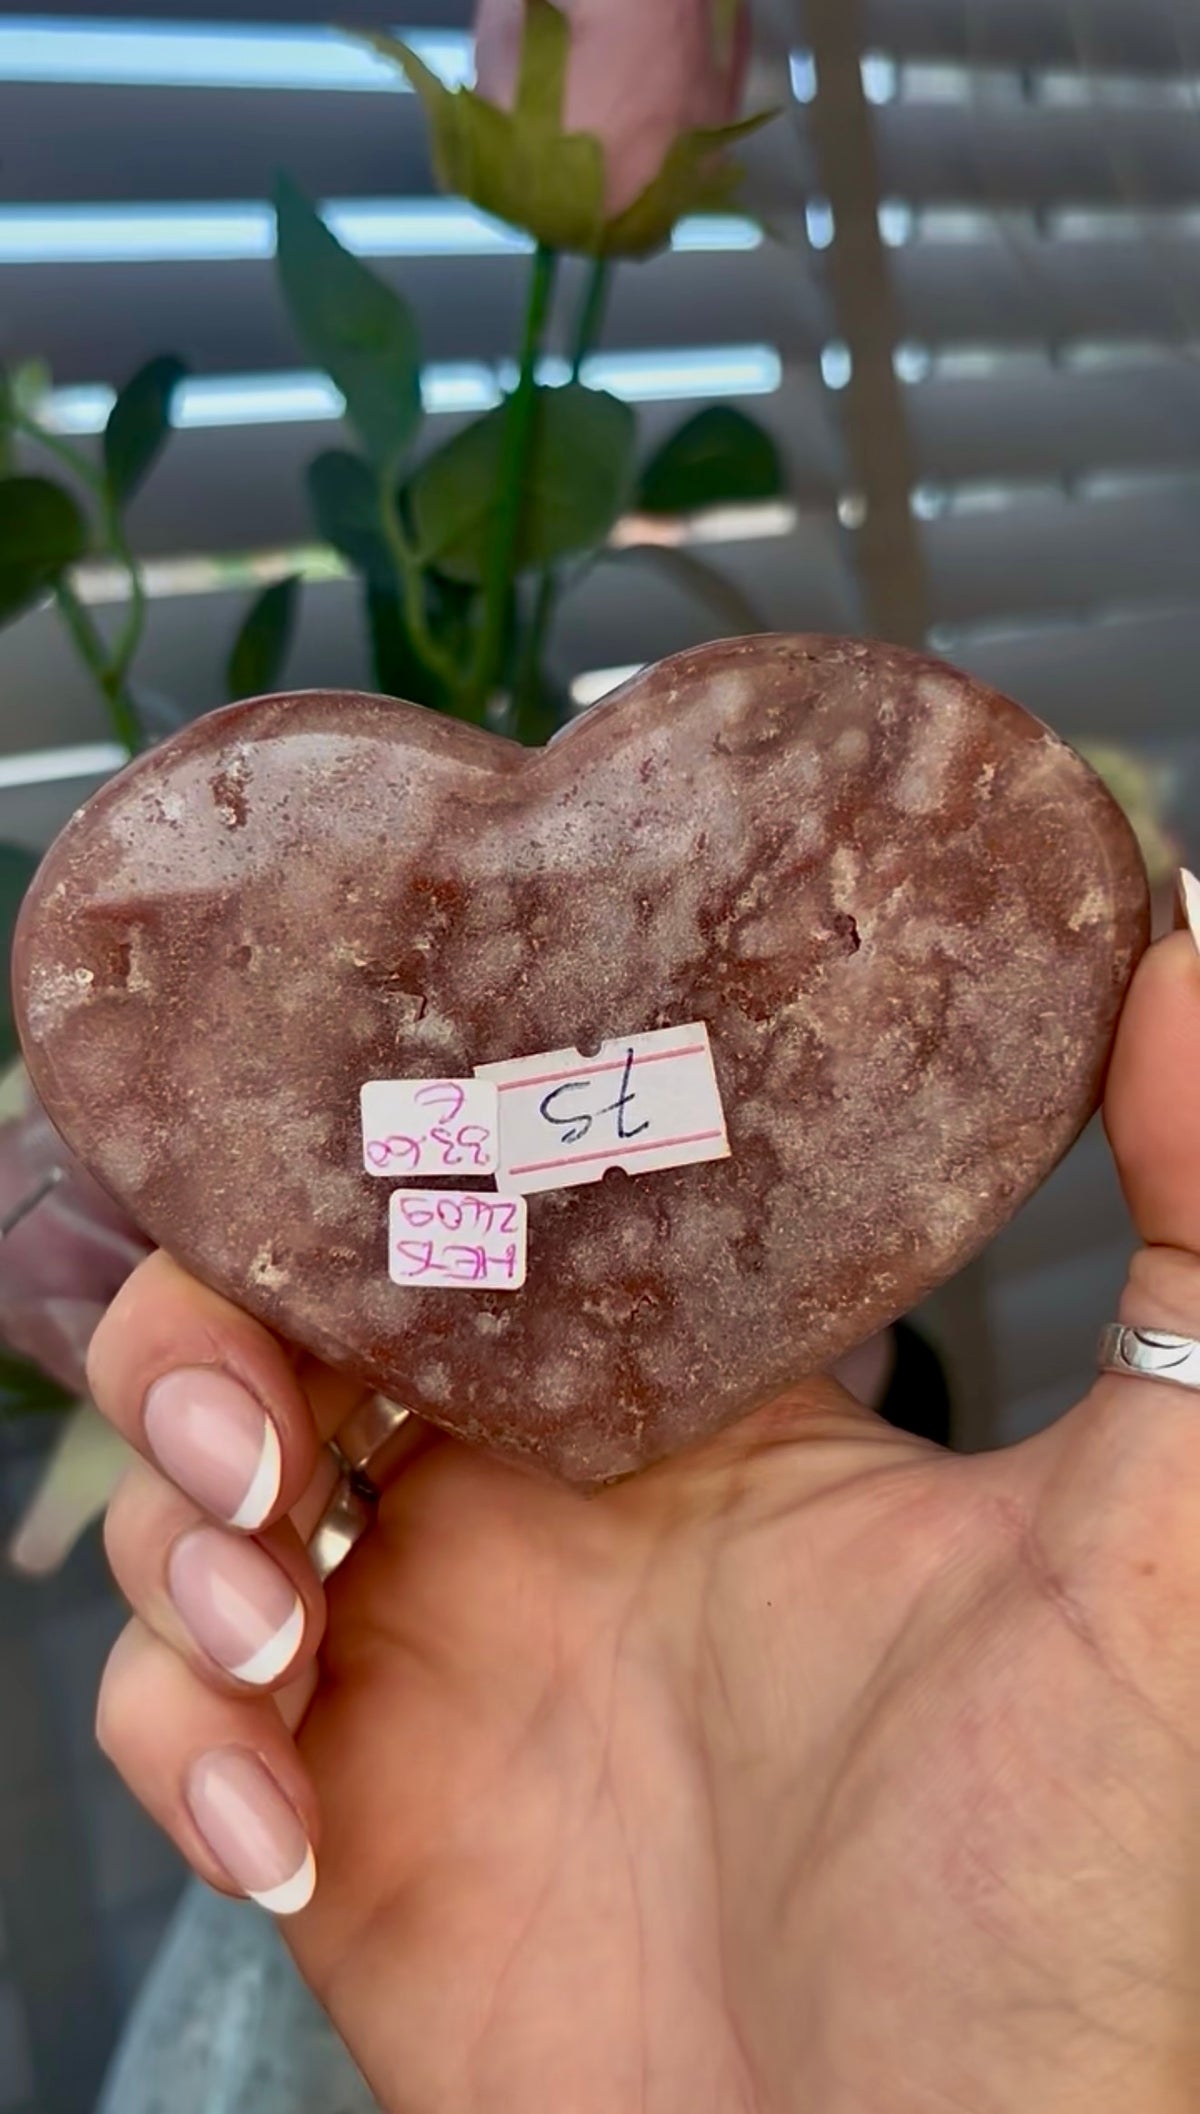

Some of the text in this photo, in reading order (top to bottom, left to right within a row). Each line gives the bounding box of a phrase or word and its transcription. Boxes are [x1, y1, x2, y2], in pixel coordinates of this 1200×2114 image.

[540, 1047, 649, 1143] 75
[367, 1125, 490, 1168] 33.60
[400, 1196, 518, 1235] 2409
